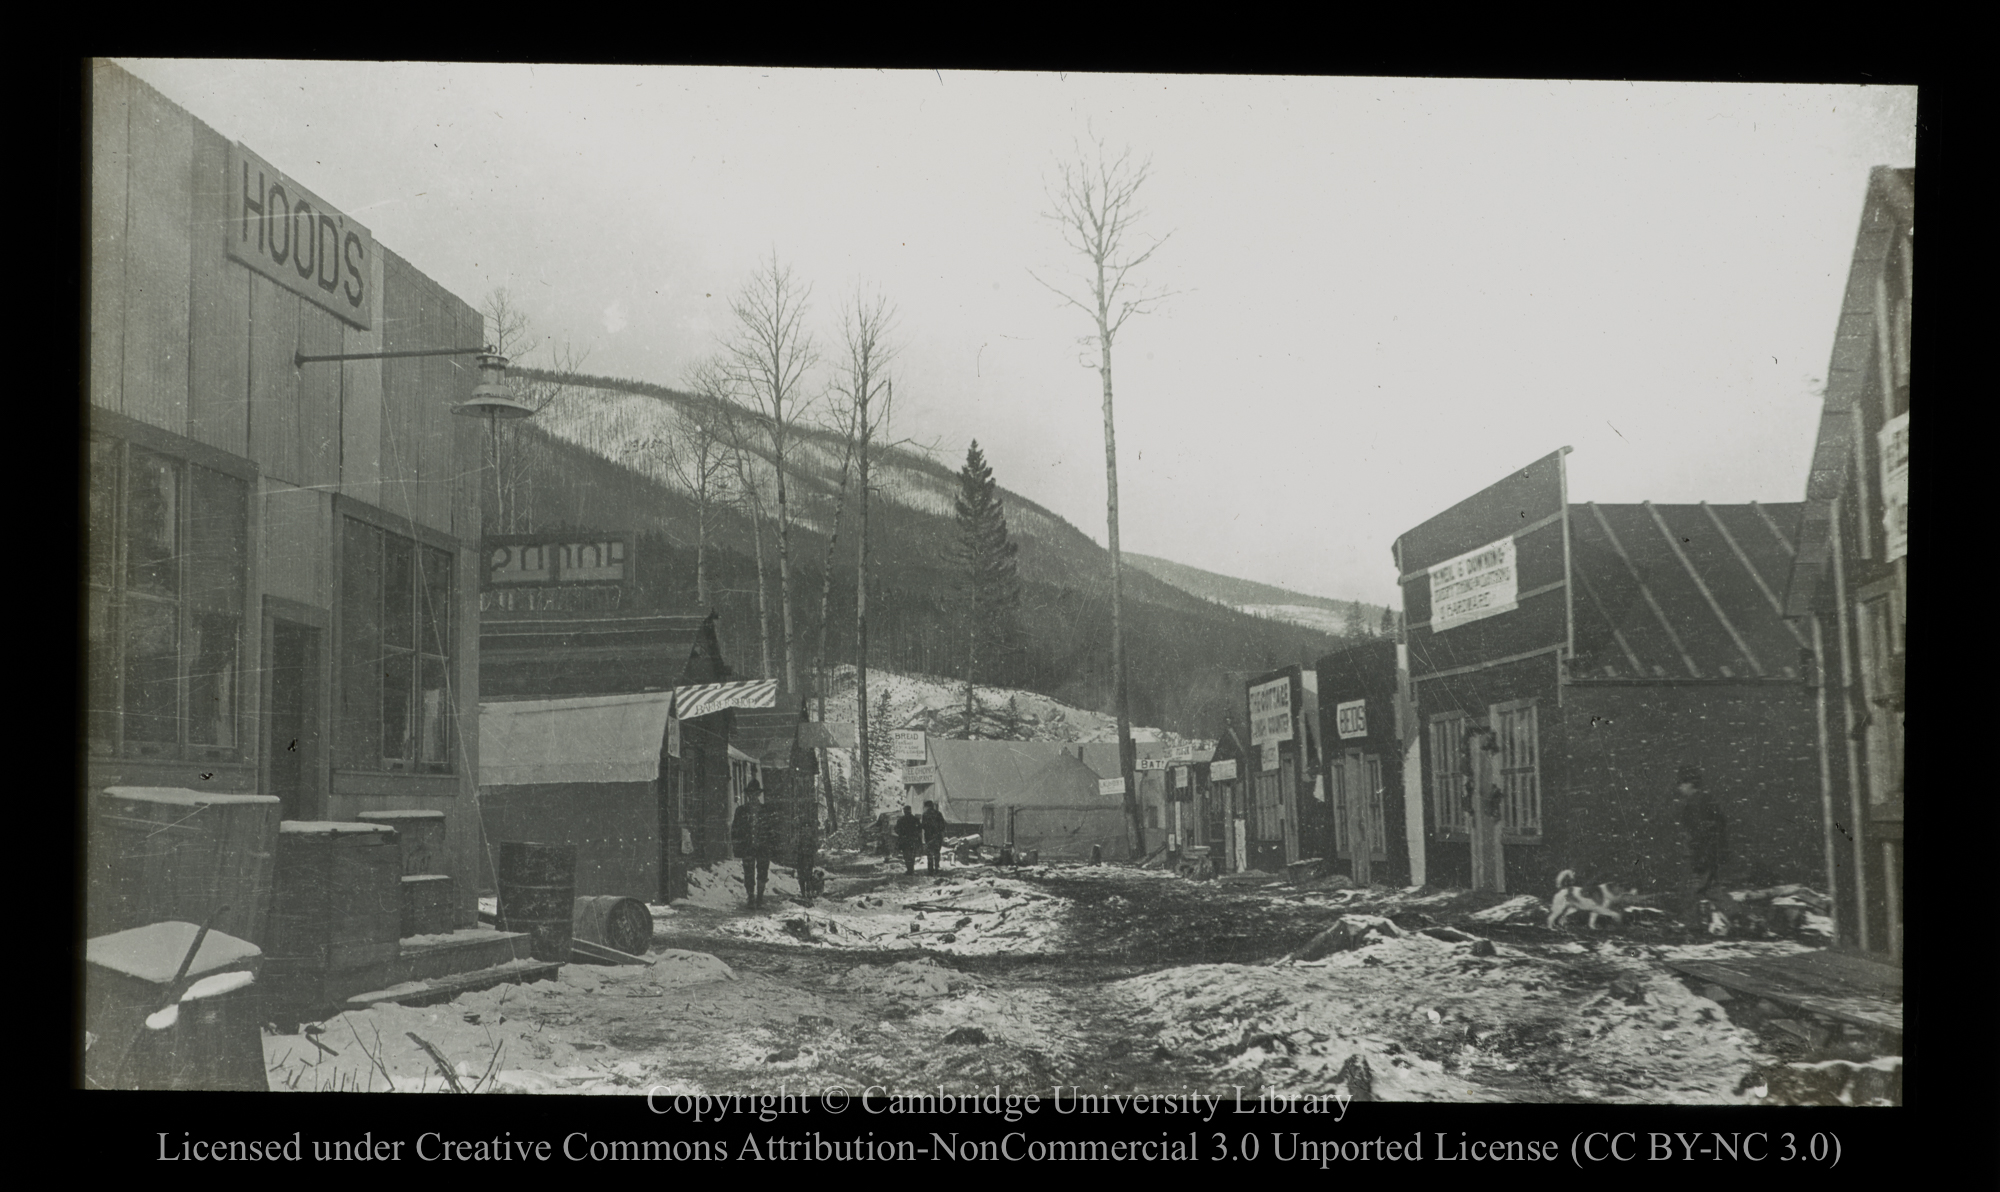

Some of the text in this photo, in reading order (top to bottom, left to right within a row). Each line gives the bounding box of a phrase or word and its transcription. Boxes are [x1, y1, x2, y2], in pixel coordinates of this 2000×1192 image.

[242, 160, 364, 308] HOOD'S
[694, 699, 730, 715] BARBER
[1340, 705, 1365, 733] BEDS
